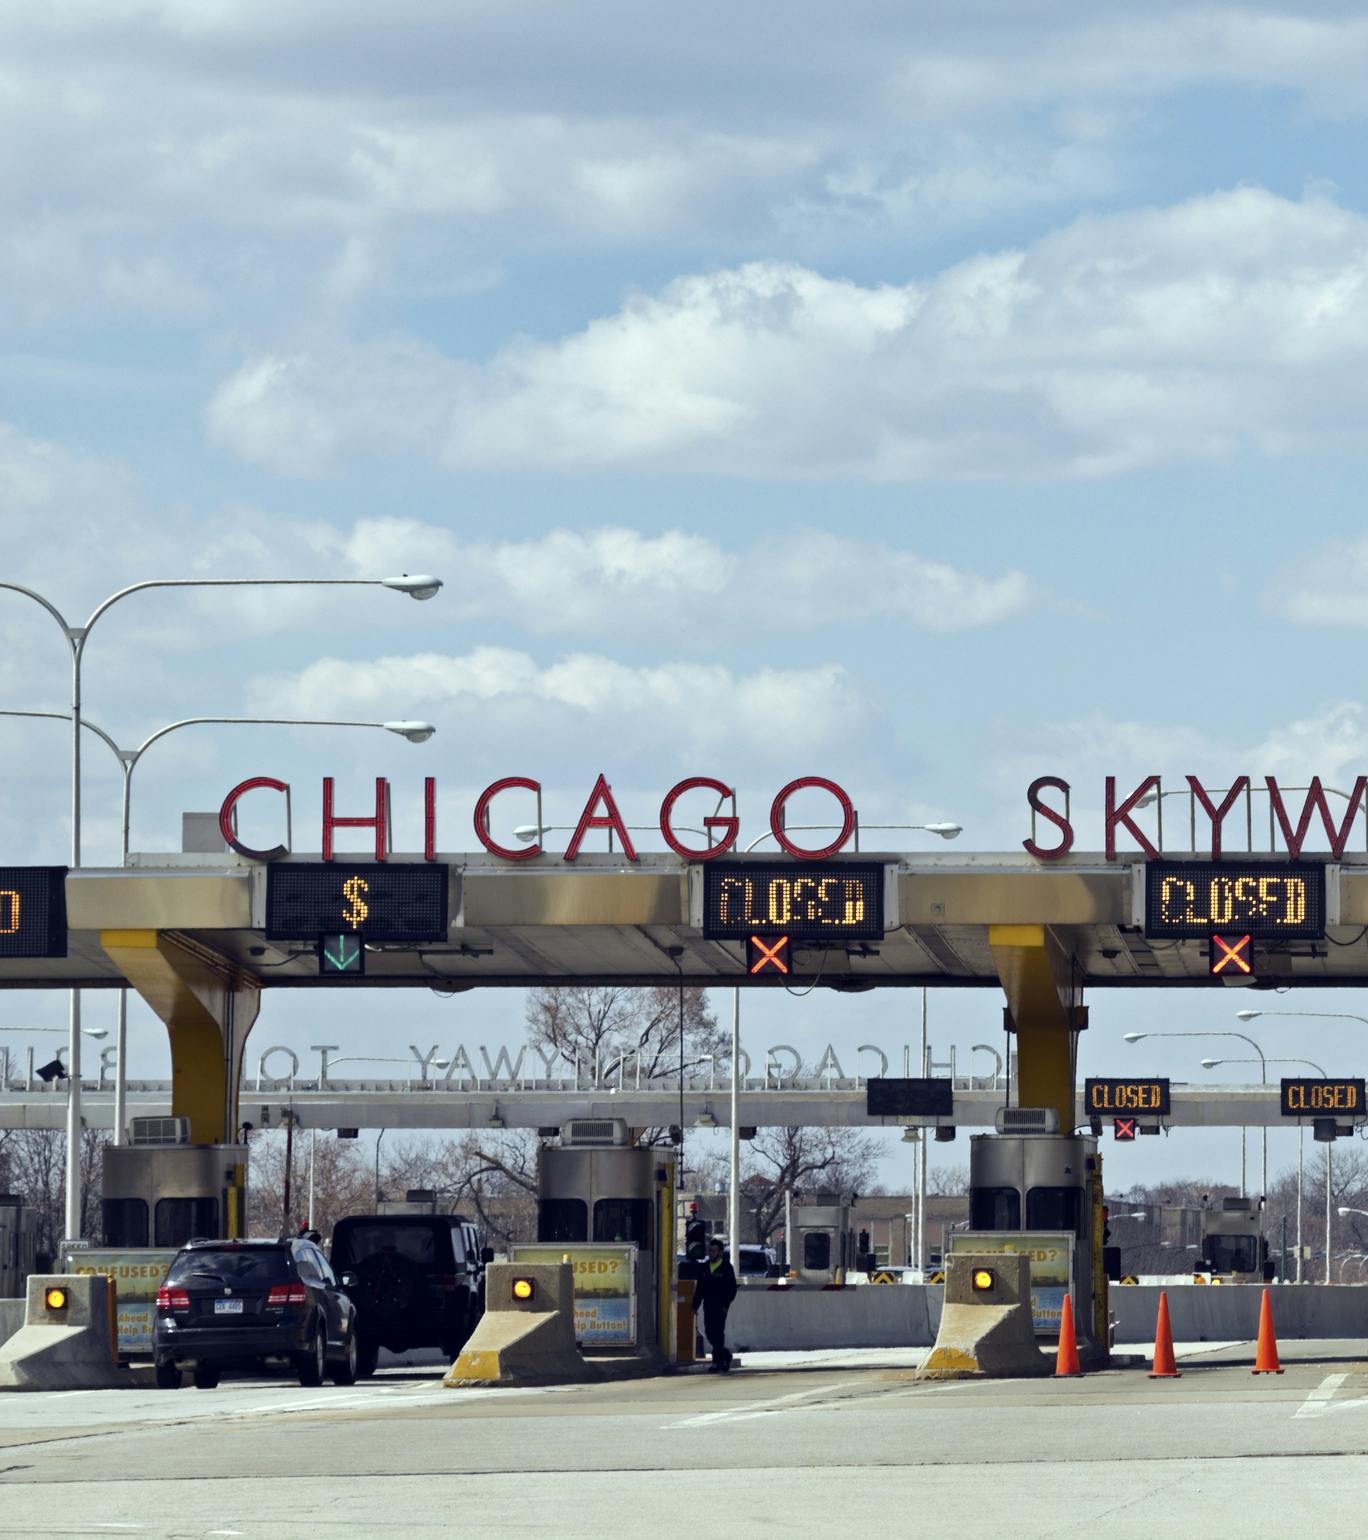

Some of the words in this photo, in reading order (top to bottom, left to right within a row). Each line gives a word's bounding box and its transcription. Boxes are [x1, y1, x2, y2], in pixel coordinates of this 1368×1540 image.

[219, 773, 855, 862] CHICAGO
[342, 876, 369, 929] $
[1092, 1085, 1161, 1108] CLOSED
[1288, 1086, 1357, 1109] CLOSED
